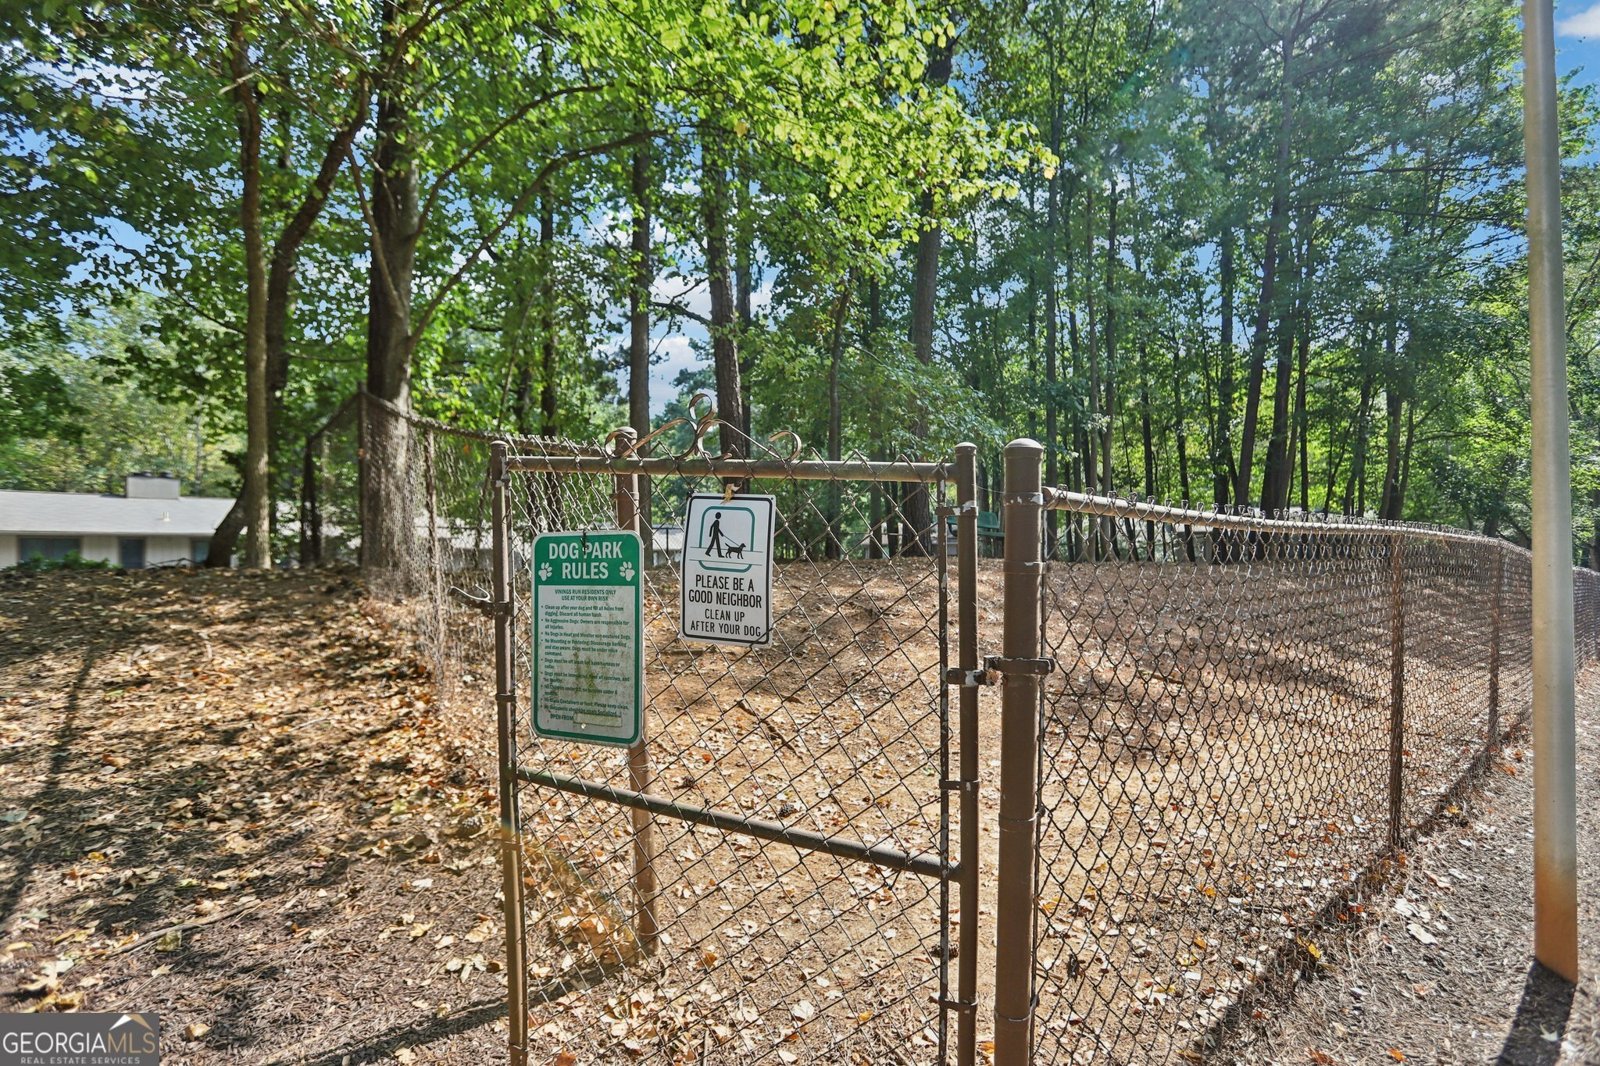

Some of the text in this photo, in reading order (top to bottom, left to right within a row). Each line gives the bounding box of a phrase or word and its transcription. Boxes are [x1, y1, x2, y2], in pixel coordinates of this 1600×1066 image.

[548, 541, 623, 560] DOG PARK
[561, 561, 609, 580] RULES
[582, 588, 605, 596] RESIDENTS
[605, 588, 617, 596] ONLY
[695, 574, 755, 593] PLEASE BE A
[688, 589, 762, 609] GOOD NEIGHBOR
[704, 608, 745, 623] CLEAN UP
[690, 620, 761, 637] AFTER YOUR DOG
